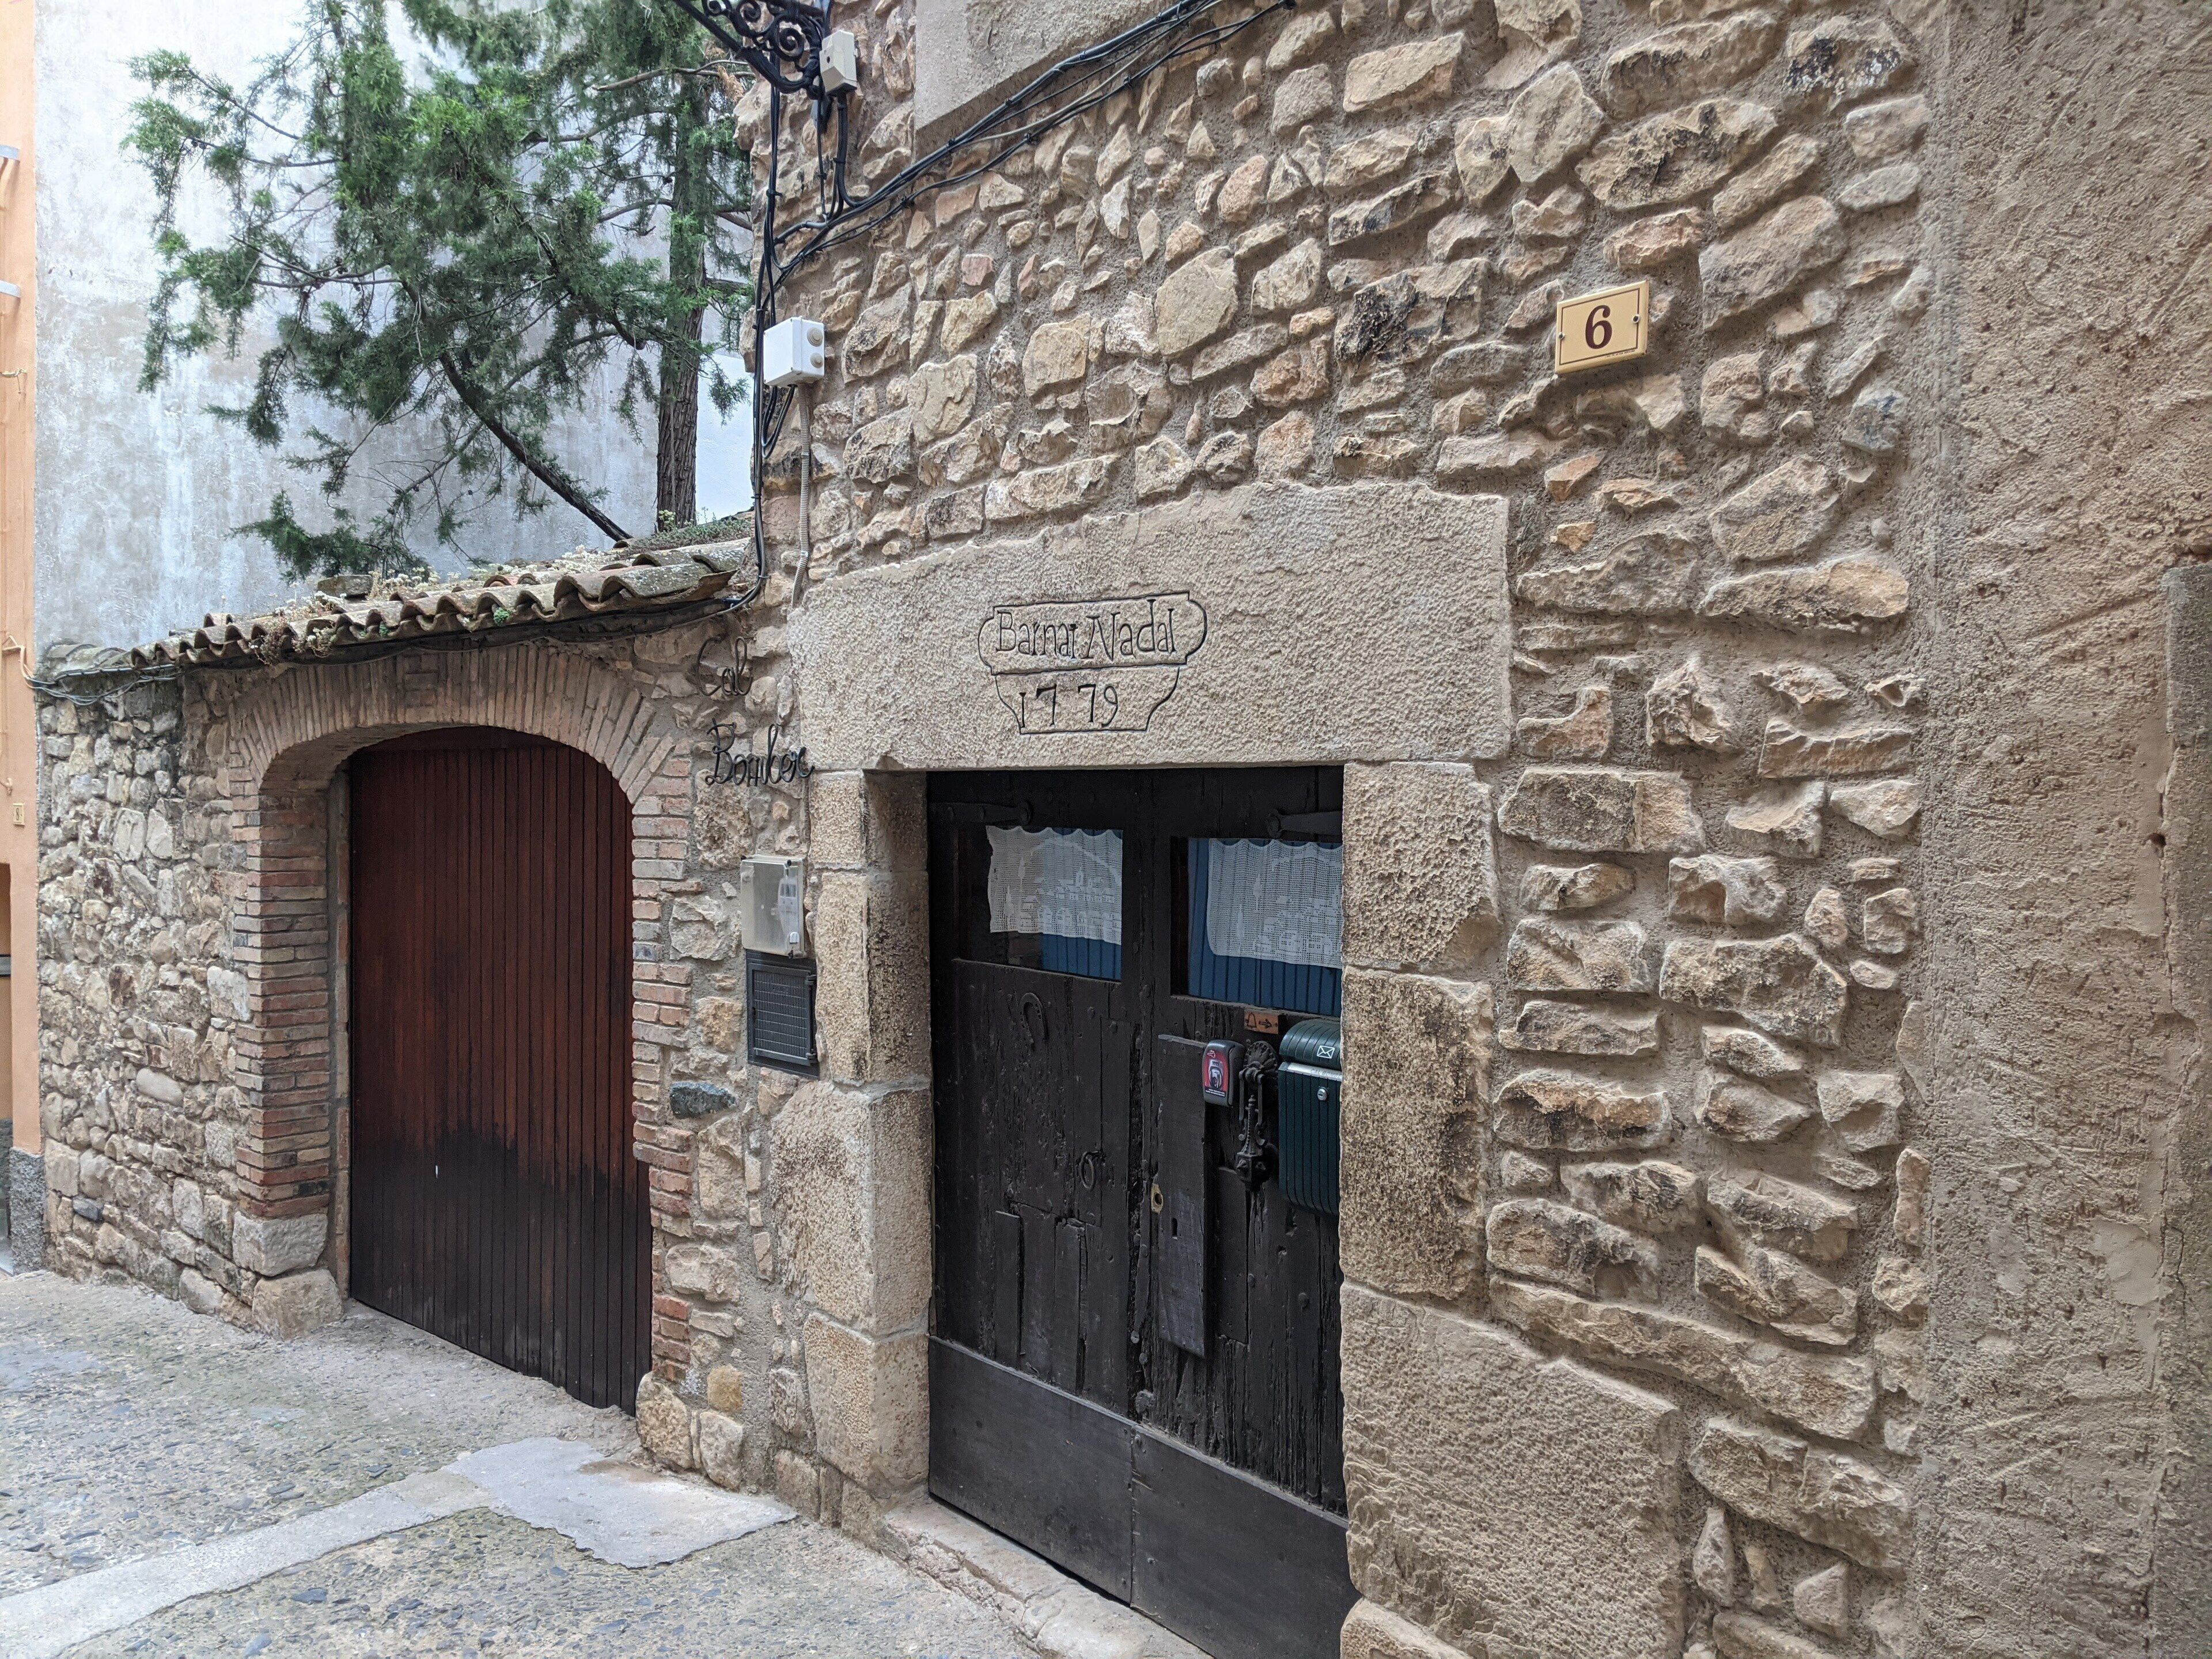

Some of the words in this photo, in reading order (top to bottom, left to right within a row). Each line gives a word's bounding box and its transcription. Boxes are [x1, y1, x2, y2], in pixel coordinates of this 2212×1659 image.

[1585, 305, 1612, 349] 6
[1082, 599, 1177, 661] Nadal
[695, 637, 753, 696] Cal
[1019, 684, 1119, 728] 1779
